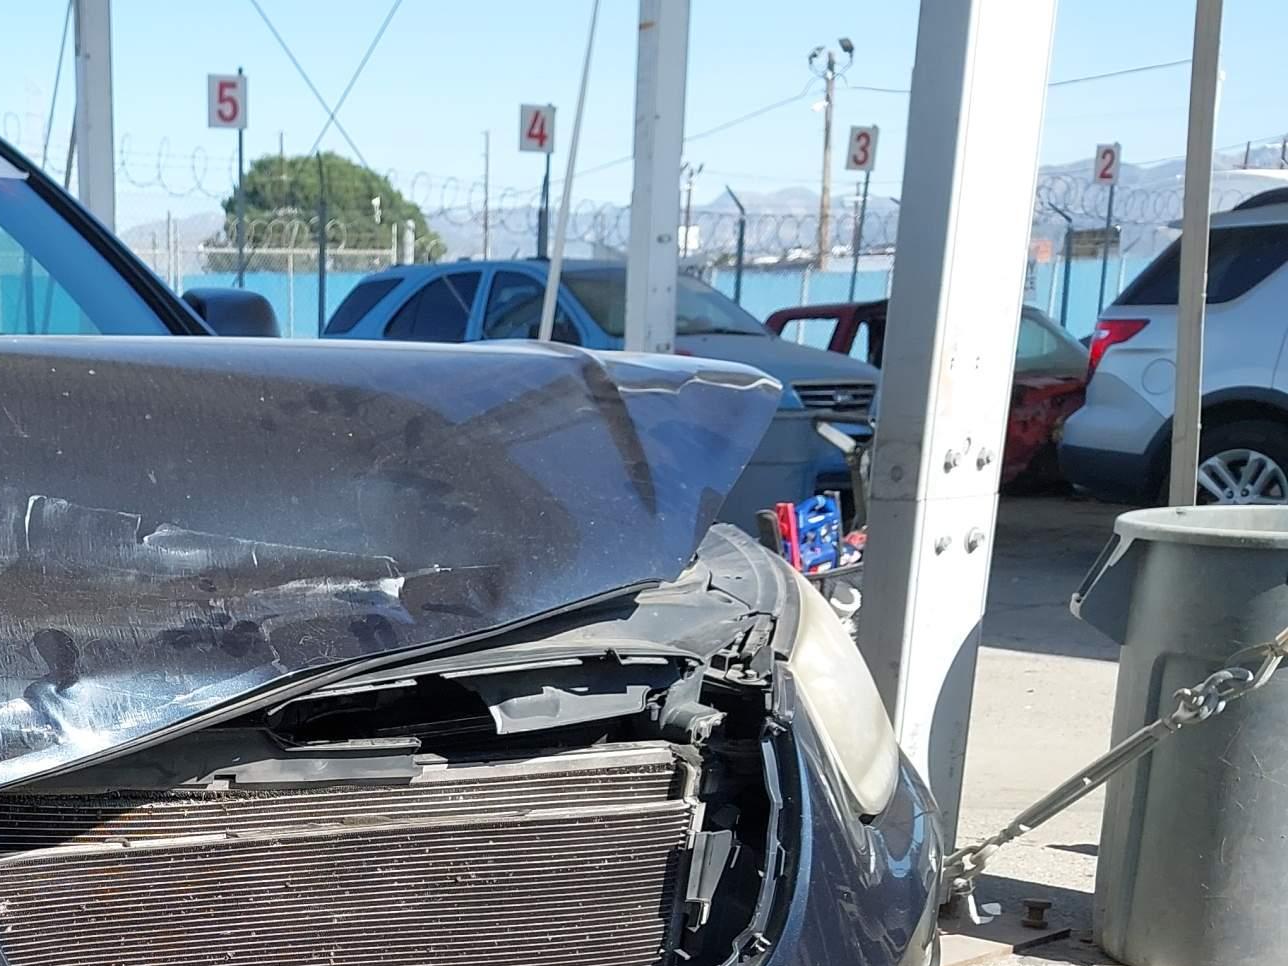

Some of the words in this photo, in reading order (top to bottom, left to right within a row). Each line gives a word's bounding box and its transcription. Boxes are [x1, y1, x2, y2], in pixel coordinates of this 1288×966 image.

[217, 81, 237, 123] 5
[528, 110, 547, 147] 4
[853, 132, 871, 165] 3
[1099, 149, 1115, 179] 2
